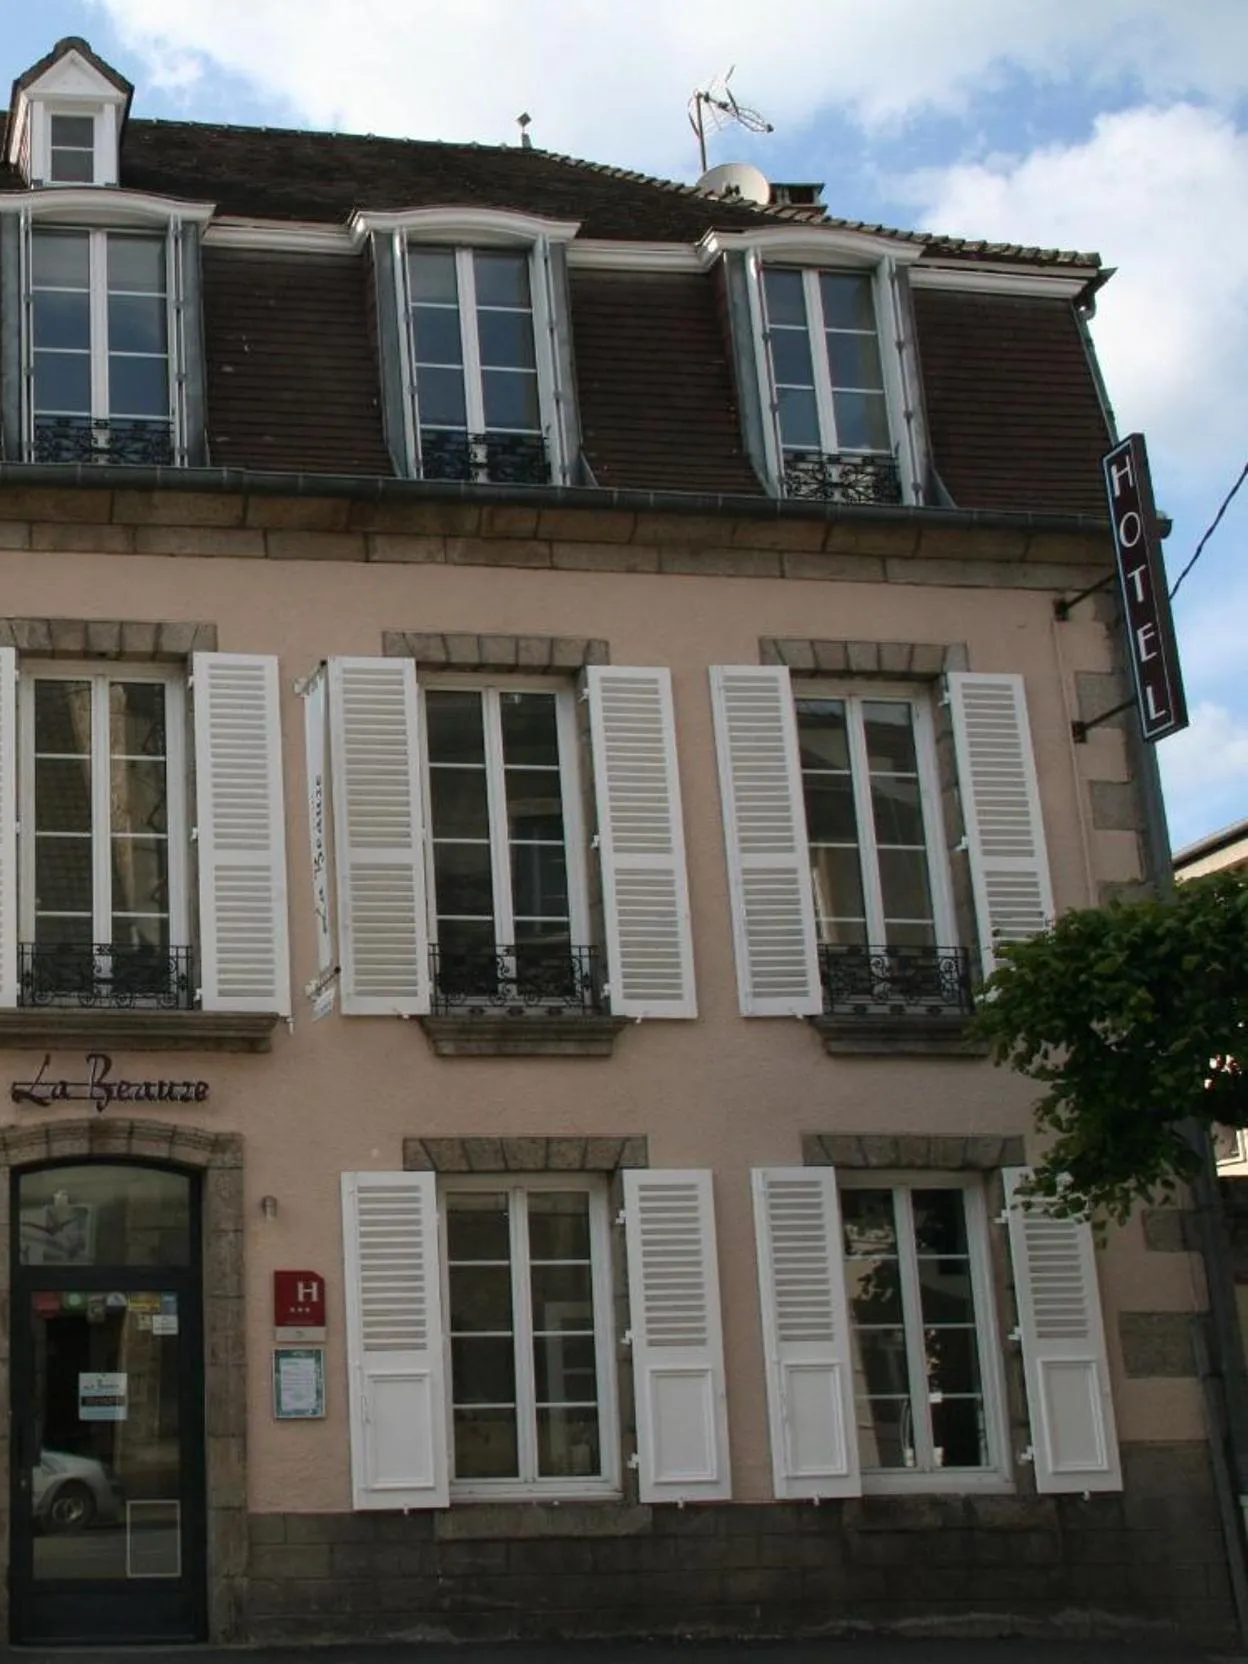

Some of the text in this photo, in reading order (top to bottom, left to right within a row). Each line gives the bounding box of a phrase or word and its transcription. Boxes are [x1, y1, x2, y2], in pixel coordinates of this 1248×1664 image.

[1110, 455, 1166, 721] HOTEL
[10, 1052, 210, 1112] La Beauze
[296, 1280, 319, 1303] H
